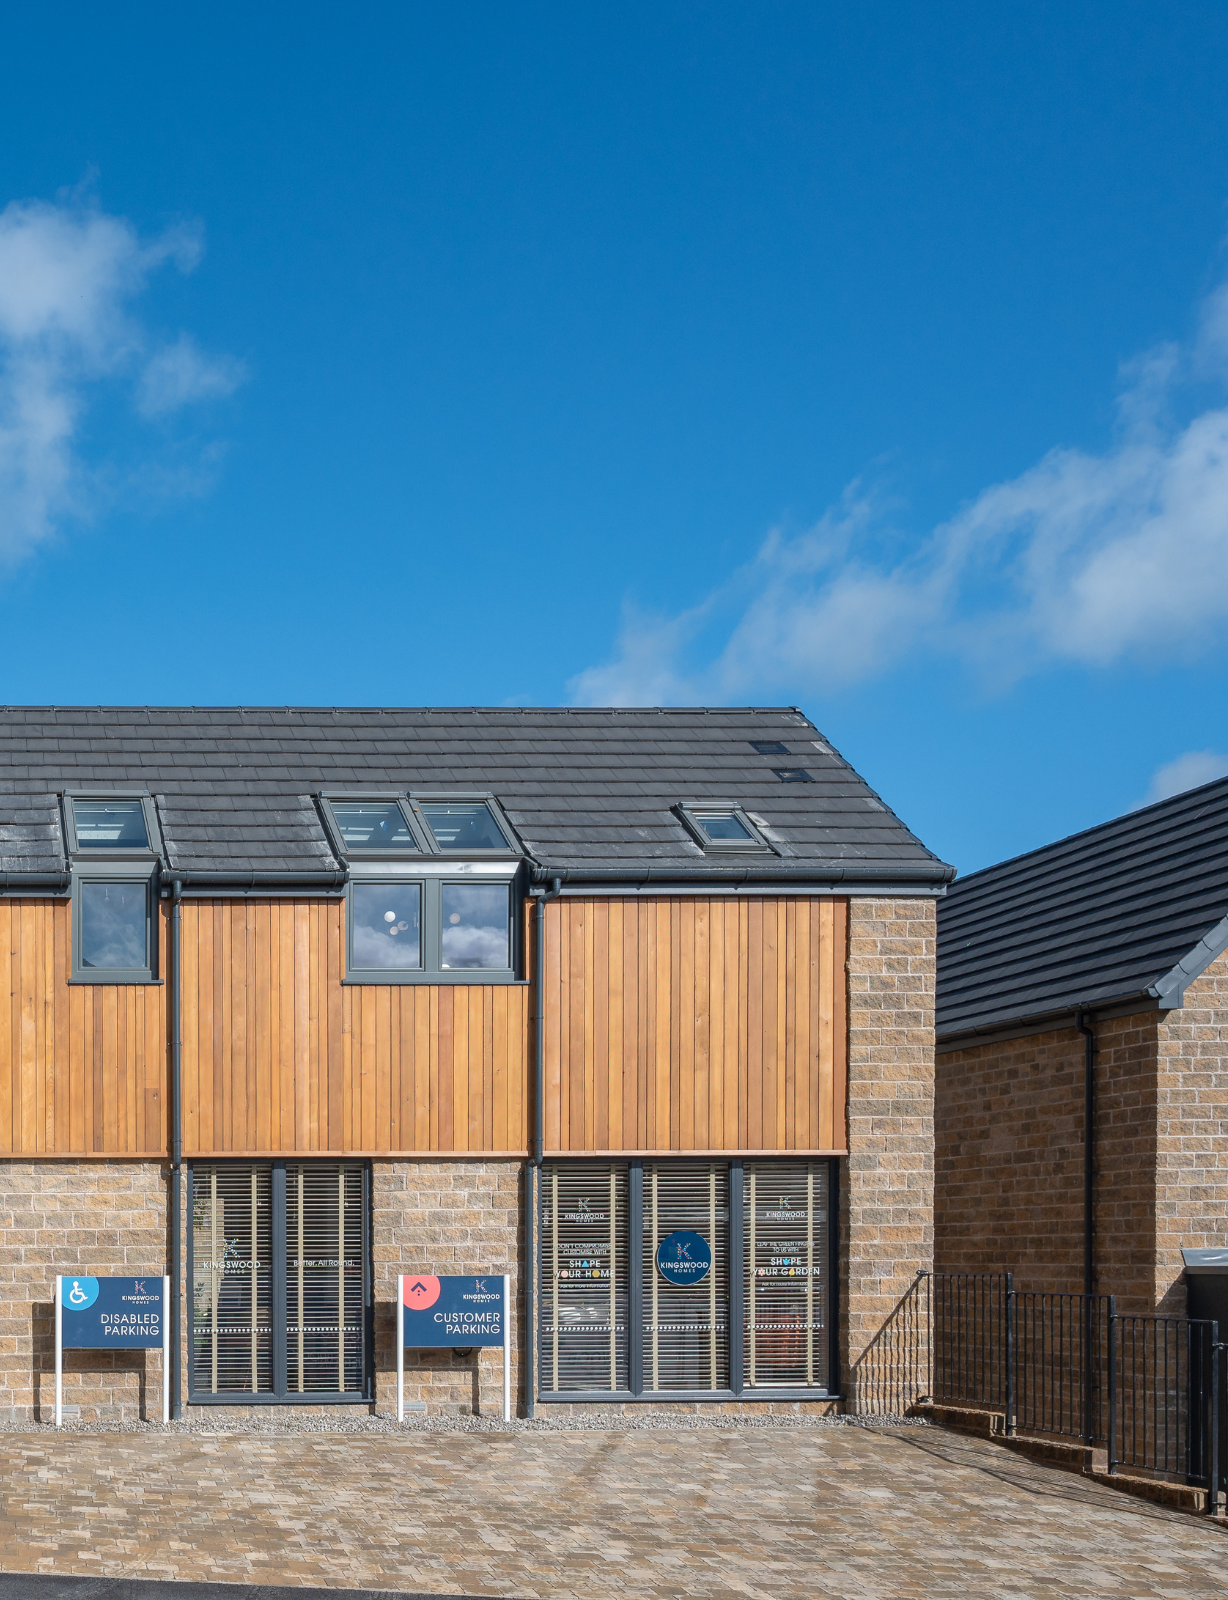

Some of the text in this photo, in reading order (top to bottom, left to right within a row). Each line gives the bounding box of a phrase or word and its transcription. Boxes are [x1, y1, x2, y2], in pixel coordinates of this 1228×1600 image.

[203, 1261, 261, 1269] KINGSWOOD
[101, 1313, 160, 1324] DISABLED
[434, 1313, 501, 1323] CUSTOMER
[104, 1325, 160, 1336] PARKING
[446, 1324, 501, 1334] PARKING
